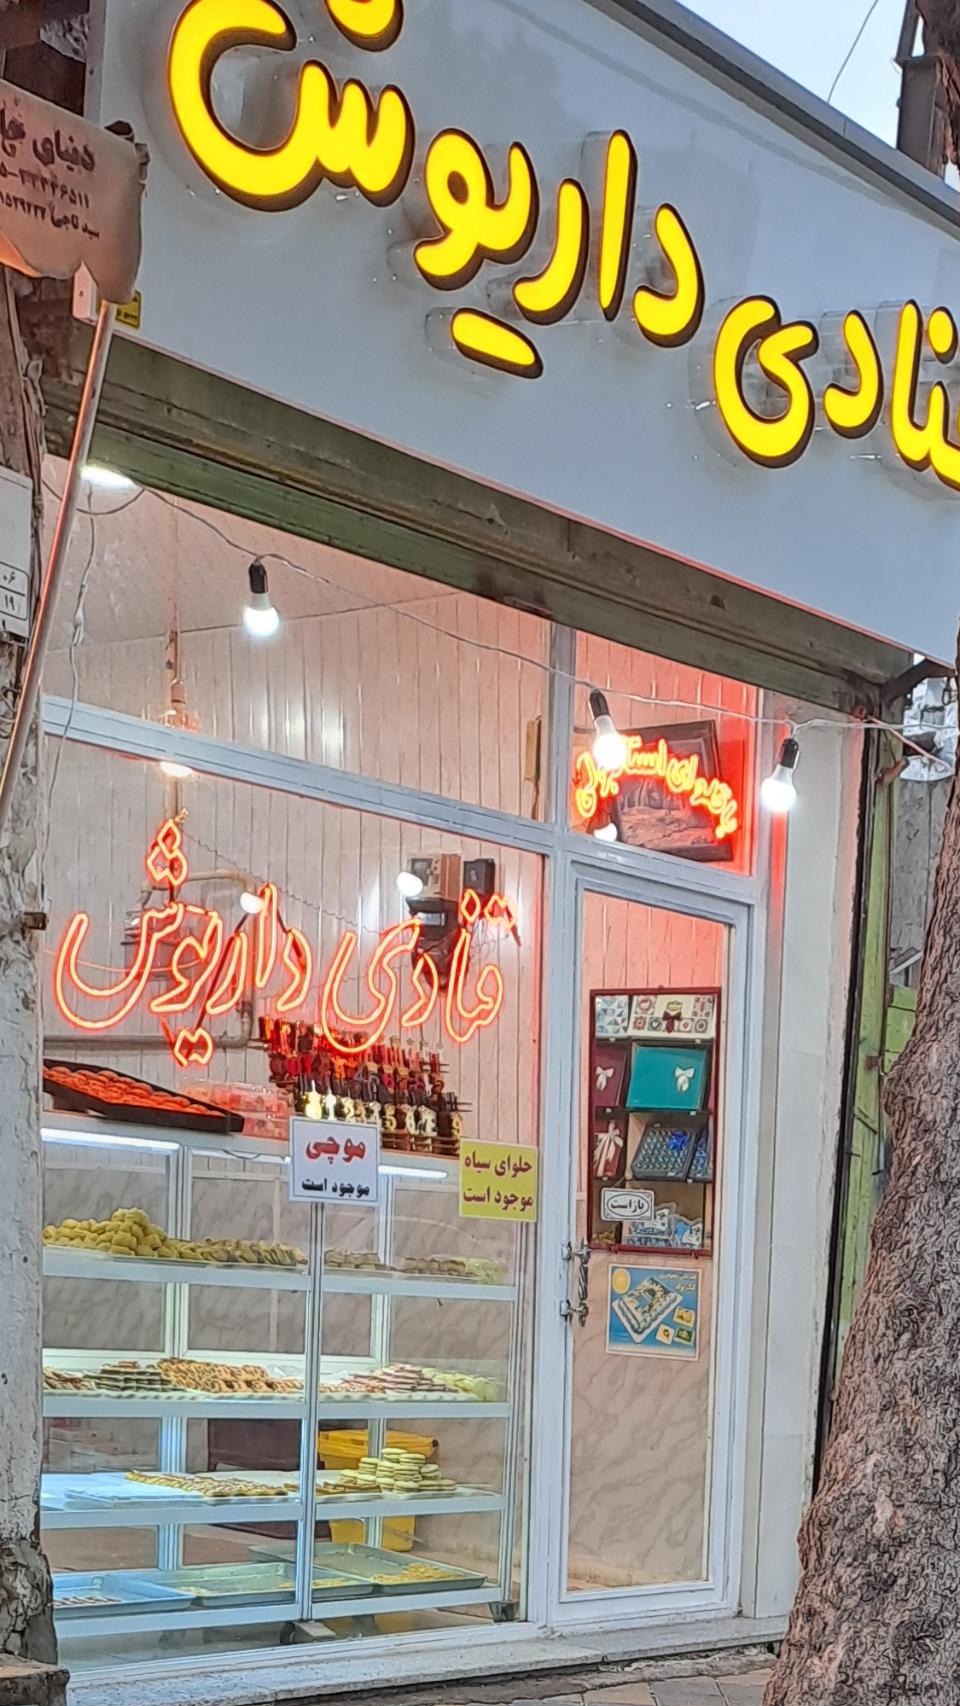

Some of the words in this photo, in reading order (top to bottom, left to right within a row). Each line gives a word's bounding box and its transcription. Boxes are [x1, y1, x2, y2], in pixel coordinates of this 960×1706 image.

[167, 0, 705, 379] داریوش
[55, 812, 312, 1067] داریوش
[320, 888, 520, 1054] قنادی
[305, 1135, 366, 1165] موچی
[464, 1149, 491, 1174] سیاه
[494, 1153, 533, 1179] حلوای
[301, 1177, 328, 1193] است
[331, 1179, 370, 1198] موجود
[463, 1187, 492, 1204] است
[494, 1191, 534, 1212] موجود
